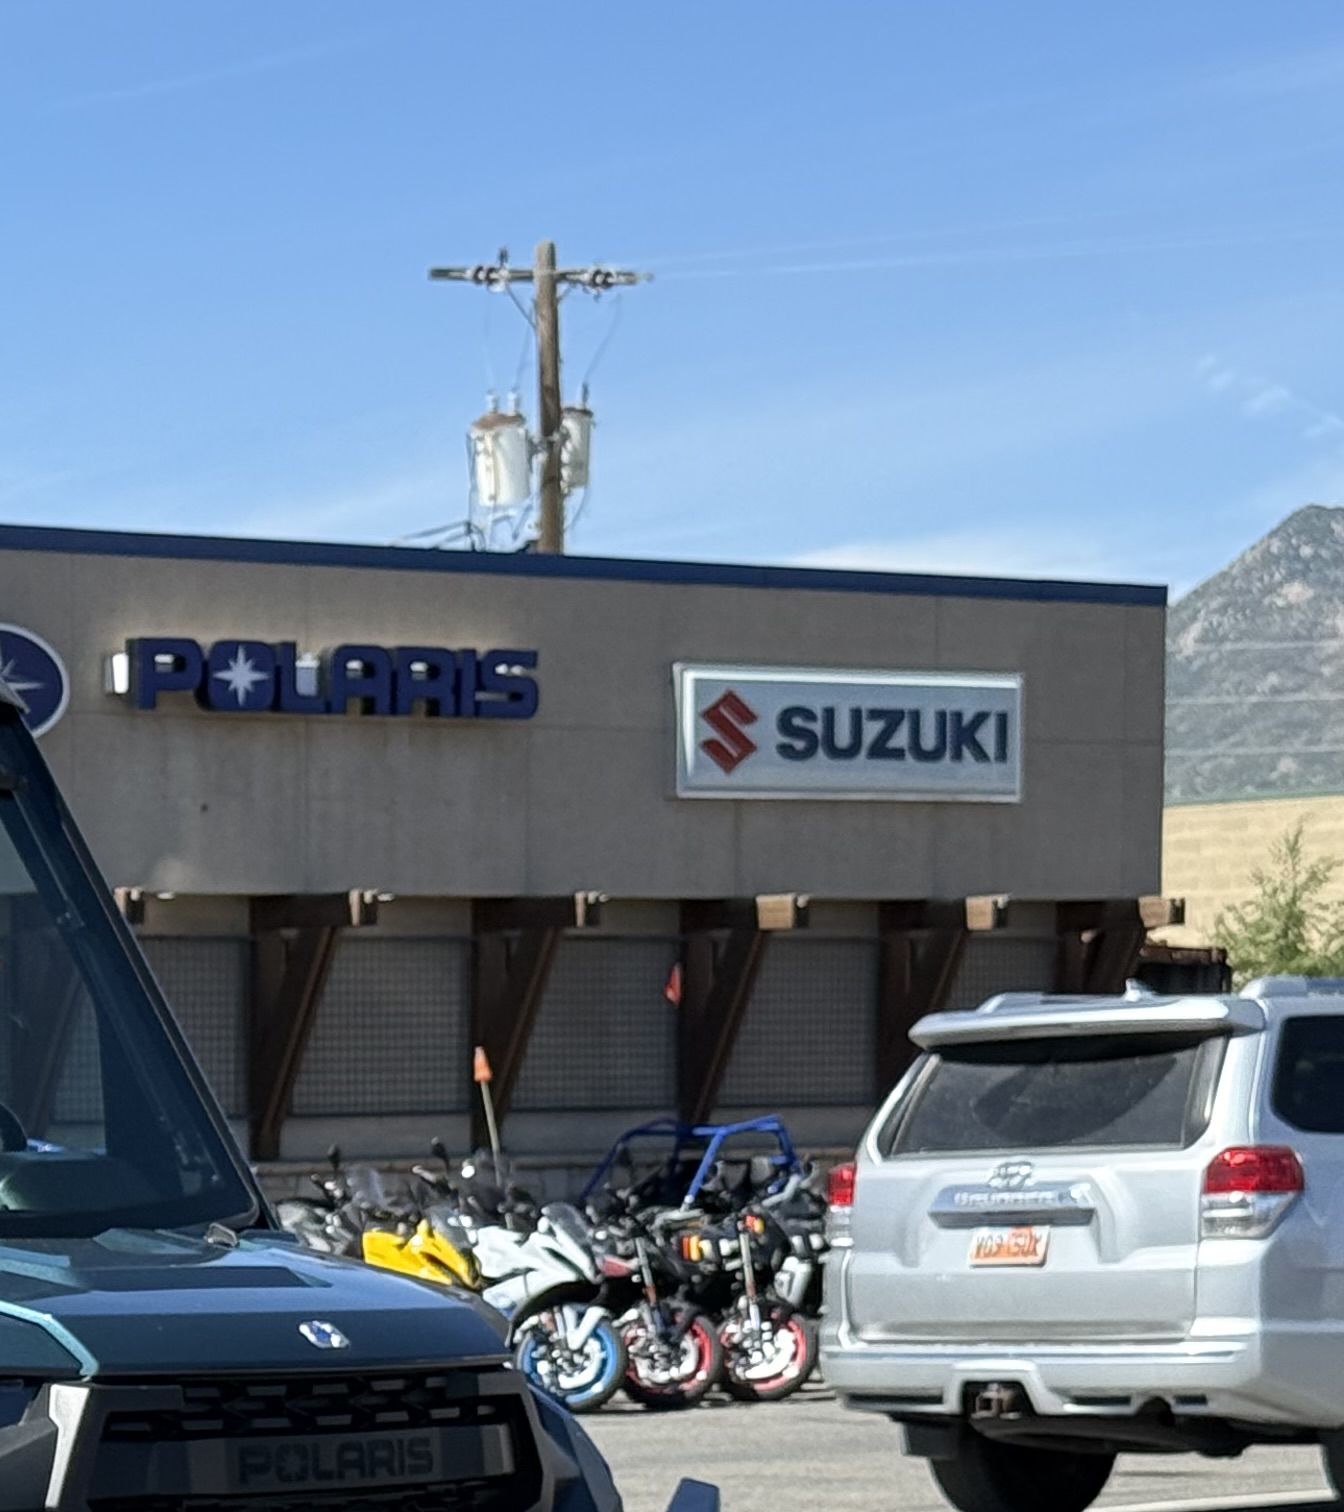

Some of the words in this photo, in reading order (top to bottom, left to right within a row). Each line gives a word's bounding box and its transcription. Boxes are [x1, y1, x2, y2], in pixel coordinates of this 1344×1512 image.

[132, 638, 539, 720] POLARIS
[775, 705, 1009, 763] SUZUKI
[238, 1438, 434, 1485] POLARIS
